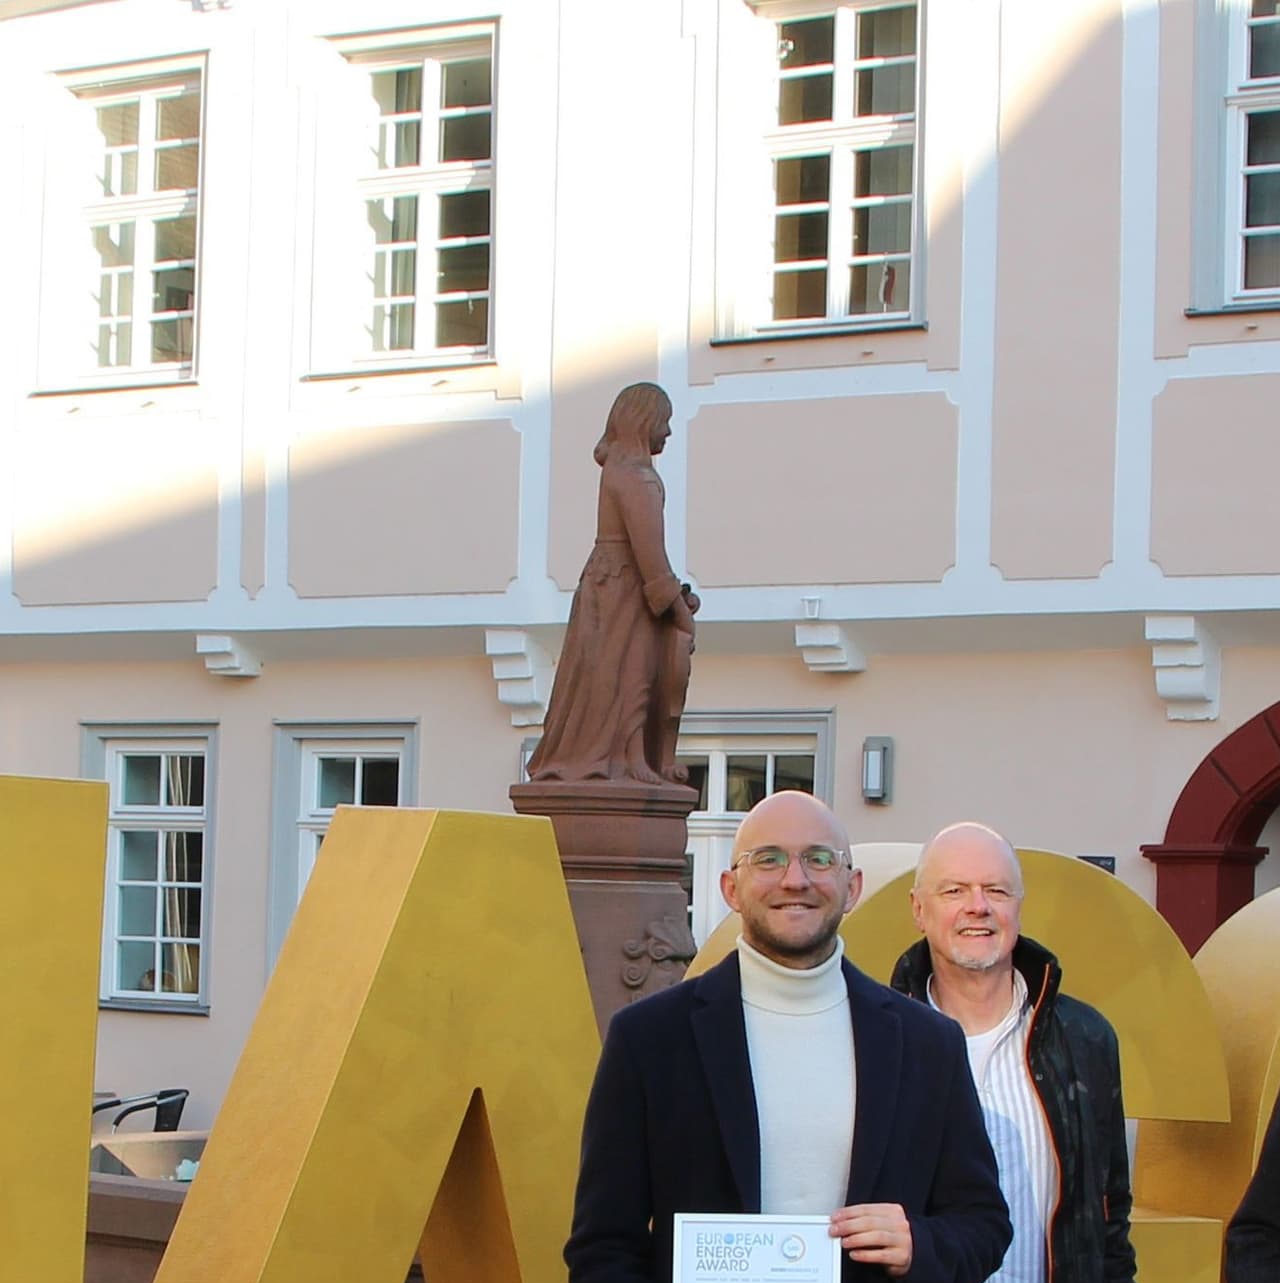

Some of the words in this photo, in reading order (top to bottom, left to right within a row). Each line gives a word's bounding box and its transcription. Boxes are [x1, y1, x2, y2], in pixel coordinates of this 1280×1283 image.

[696, 1232, 774, 1246] EUROPEAN
[695, 1246, 753, 1259] ENERGY
[695, 1259, 750, 1272] AWARD
